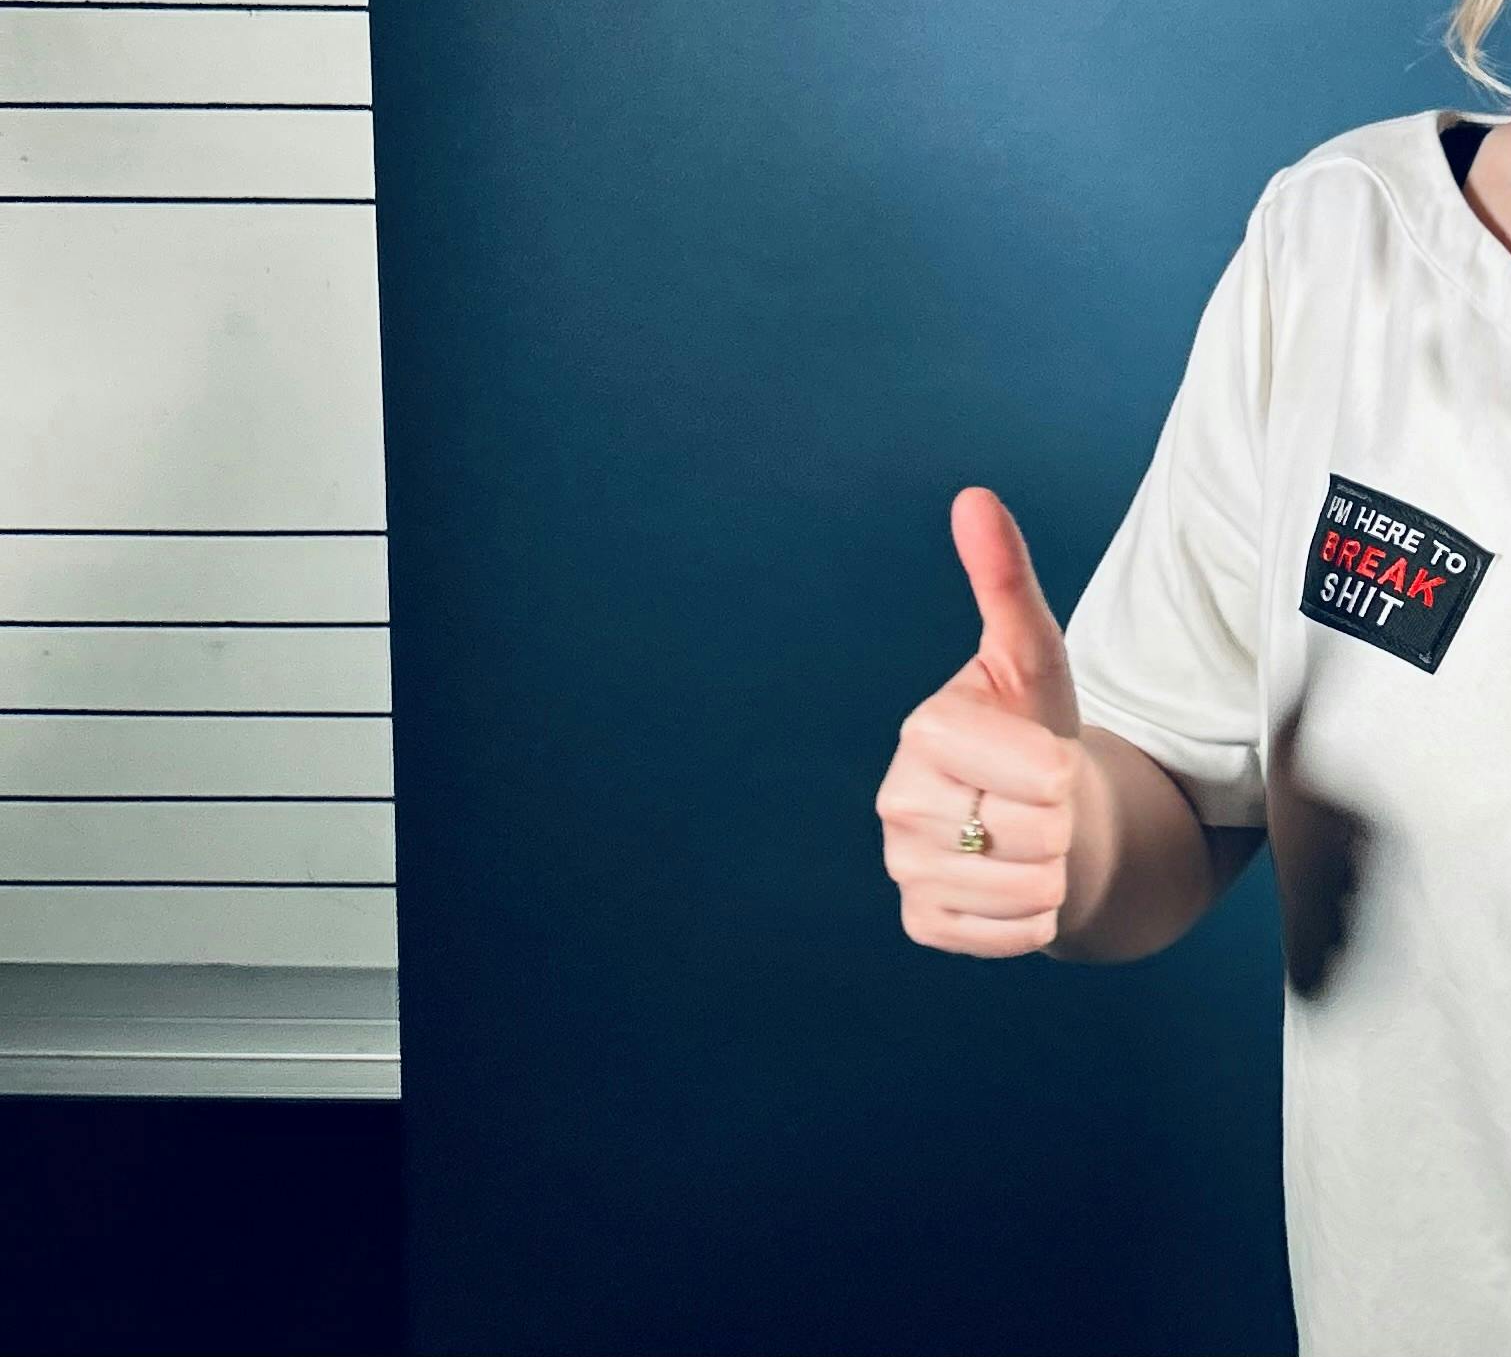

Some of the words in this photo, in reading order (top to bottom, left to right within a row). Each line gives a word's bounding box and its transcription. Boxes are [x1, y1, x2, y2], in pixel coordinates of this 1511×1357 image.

[1319, 529, 1447, 608] BREAK
[1354, 506, 1425, 554] HERE
[1430, 539, 1468, 574] TO
[1320, 572, 1405, 626] SHIT
